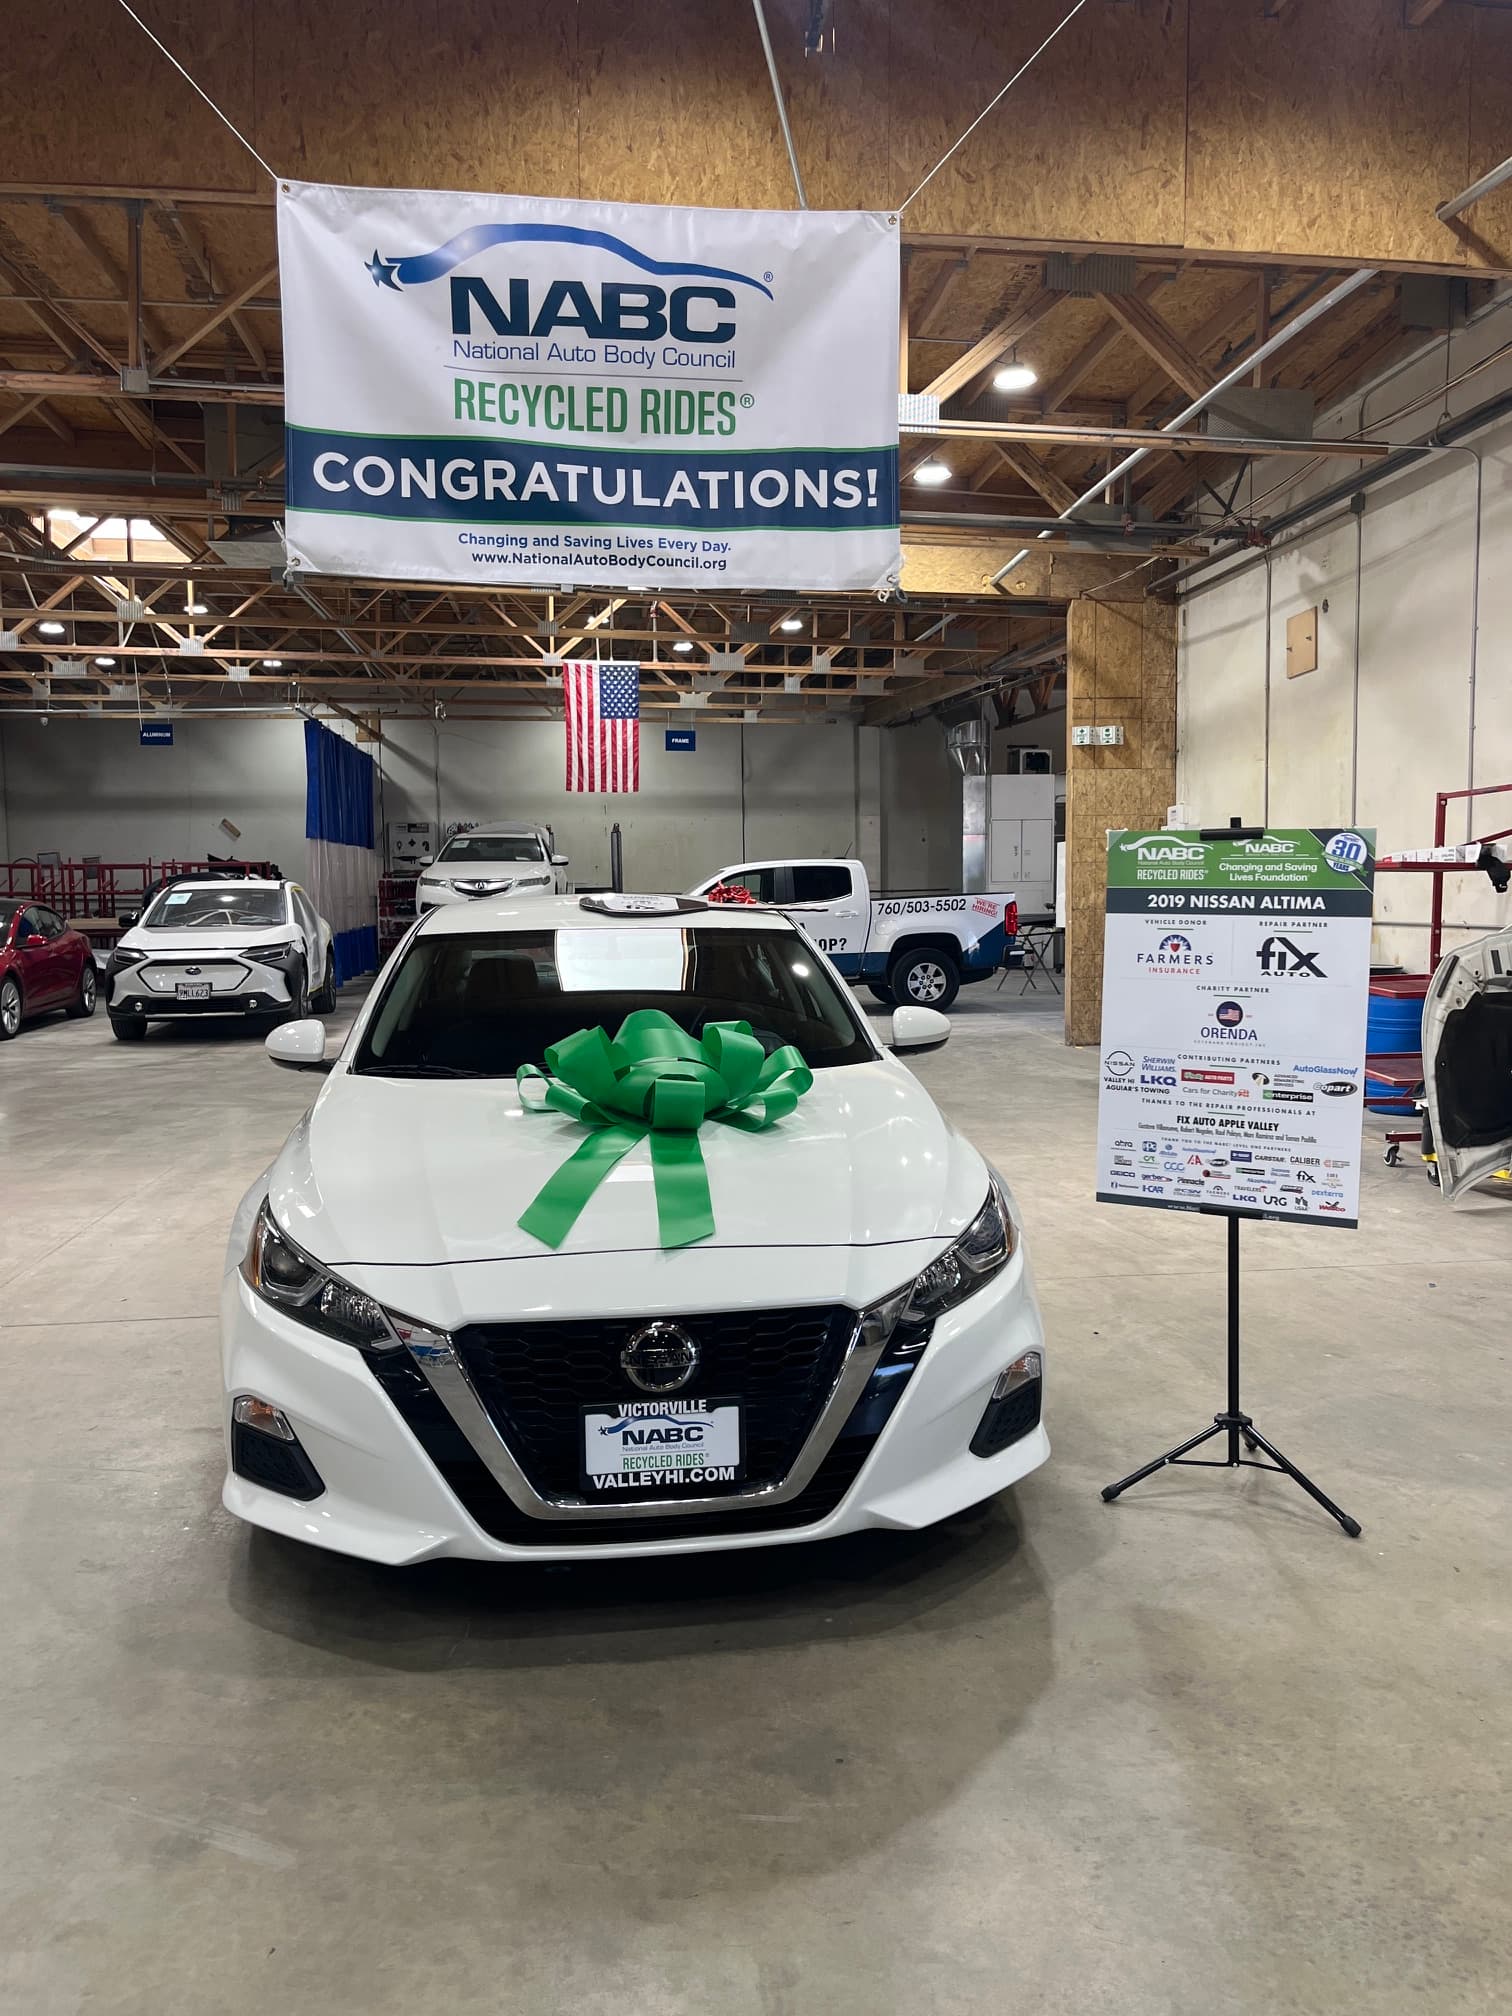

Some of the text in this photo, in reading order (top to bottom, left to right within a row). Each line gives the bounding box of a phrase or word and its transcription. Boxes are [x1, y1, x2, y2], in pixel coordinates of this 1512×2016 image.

[450, 276, 736, 343] NABC
[453, 339, 735, 369] National Auto Body Council
[454, 378, 627, 433] RECYCLED
[312, 451, 879, 510] CONGRATULATIONS!
[458, 533, 731, 553] Changing and Saving Lives Every Day.
[472, 552, 727, 571] www.NationalAutoBodyCouncil.org
[1137, 847, 1204, 860] NABC
[1245, 844, 1294, 853] NABC
[1332, 839, 1362, 861] 30
[1219, 863, 1317, 873] Changing and Saving
[1333, 862, 1350, 872] YEARS
[1137, 869, 1178, 880] RECYCLED
[1230, 873, 1308, 881] Lives Foundation
[878, 898, 967, 915] 760/503-5502
[1147, 894, 1326, 910] 2019 NISSAN ALTIMA
[972, 903, 998, 916] HIRING!
[814, 937, 847, 951] OP?
[1137, 953, 1214, 965] FARMERS
[1200, 1027, 1258, 1040] ORENDA
[1142, 1055, 1176, 1065] SHERWIN
[1177, 1054, 1237, 1063] CONTRIBUTING
[1140, 1075, 1177, 1087] LKQ
[1313, 1081, 1351, 1092] Copart
[1106, 1084, 1139, 1092] AGUIAR'S
[1182, 1086, 1199, 1094] Cars
[1212, 1089, 1237, 1097] Charity
[1264, 1091, 1313, 1100] enterprise
[1237, 1105, 1302, 1115] PROFESSIONALS
[1176, 1115, 1279, 1131] FIX AUTO APPLE VALLEY
[1164, 1161, 1184, 1171] CCC
[1290, 1156, 1320, 1165] CALIBER
[1232, 1194, 1257, 1202] LKQ
[1264, 1195, 1287, 1206] URG
[617, 1399, 707, 1418] VICTORVILLE
[622, 1426, 704, 1445] NABC
[623, 1454, 672, 1470] RECYCLED
[592, 1467, 735, 1489] VALLEYHI.COM
